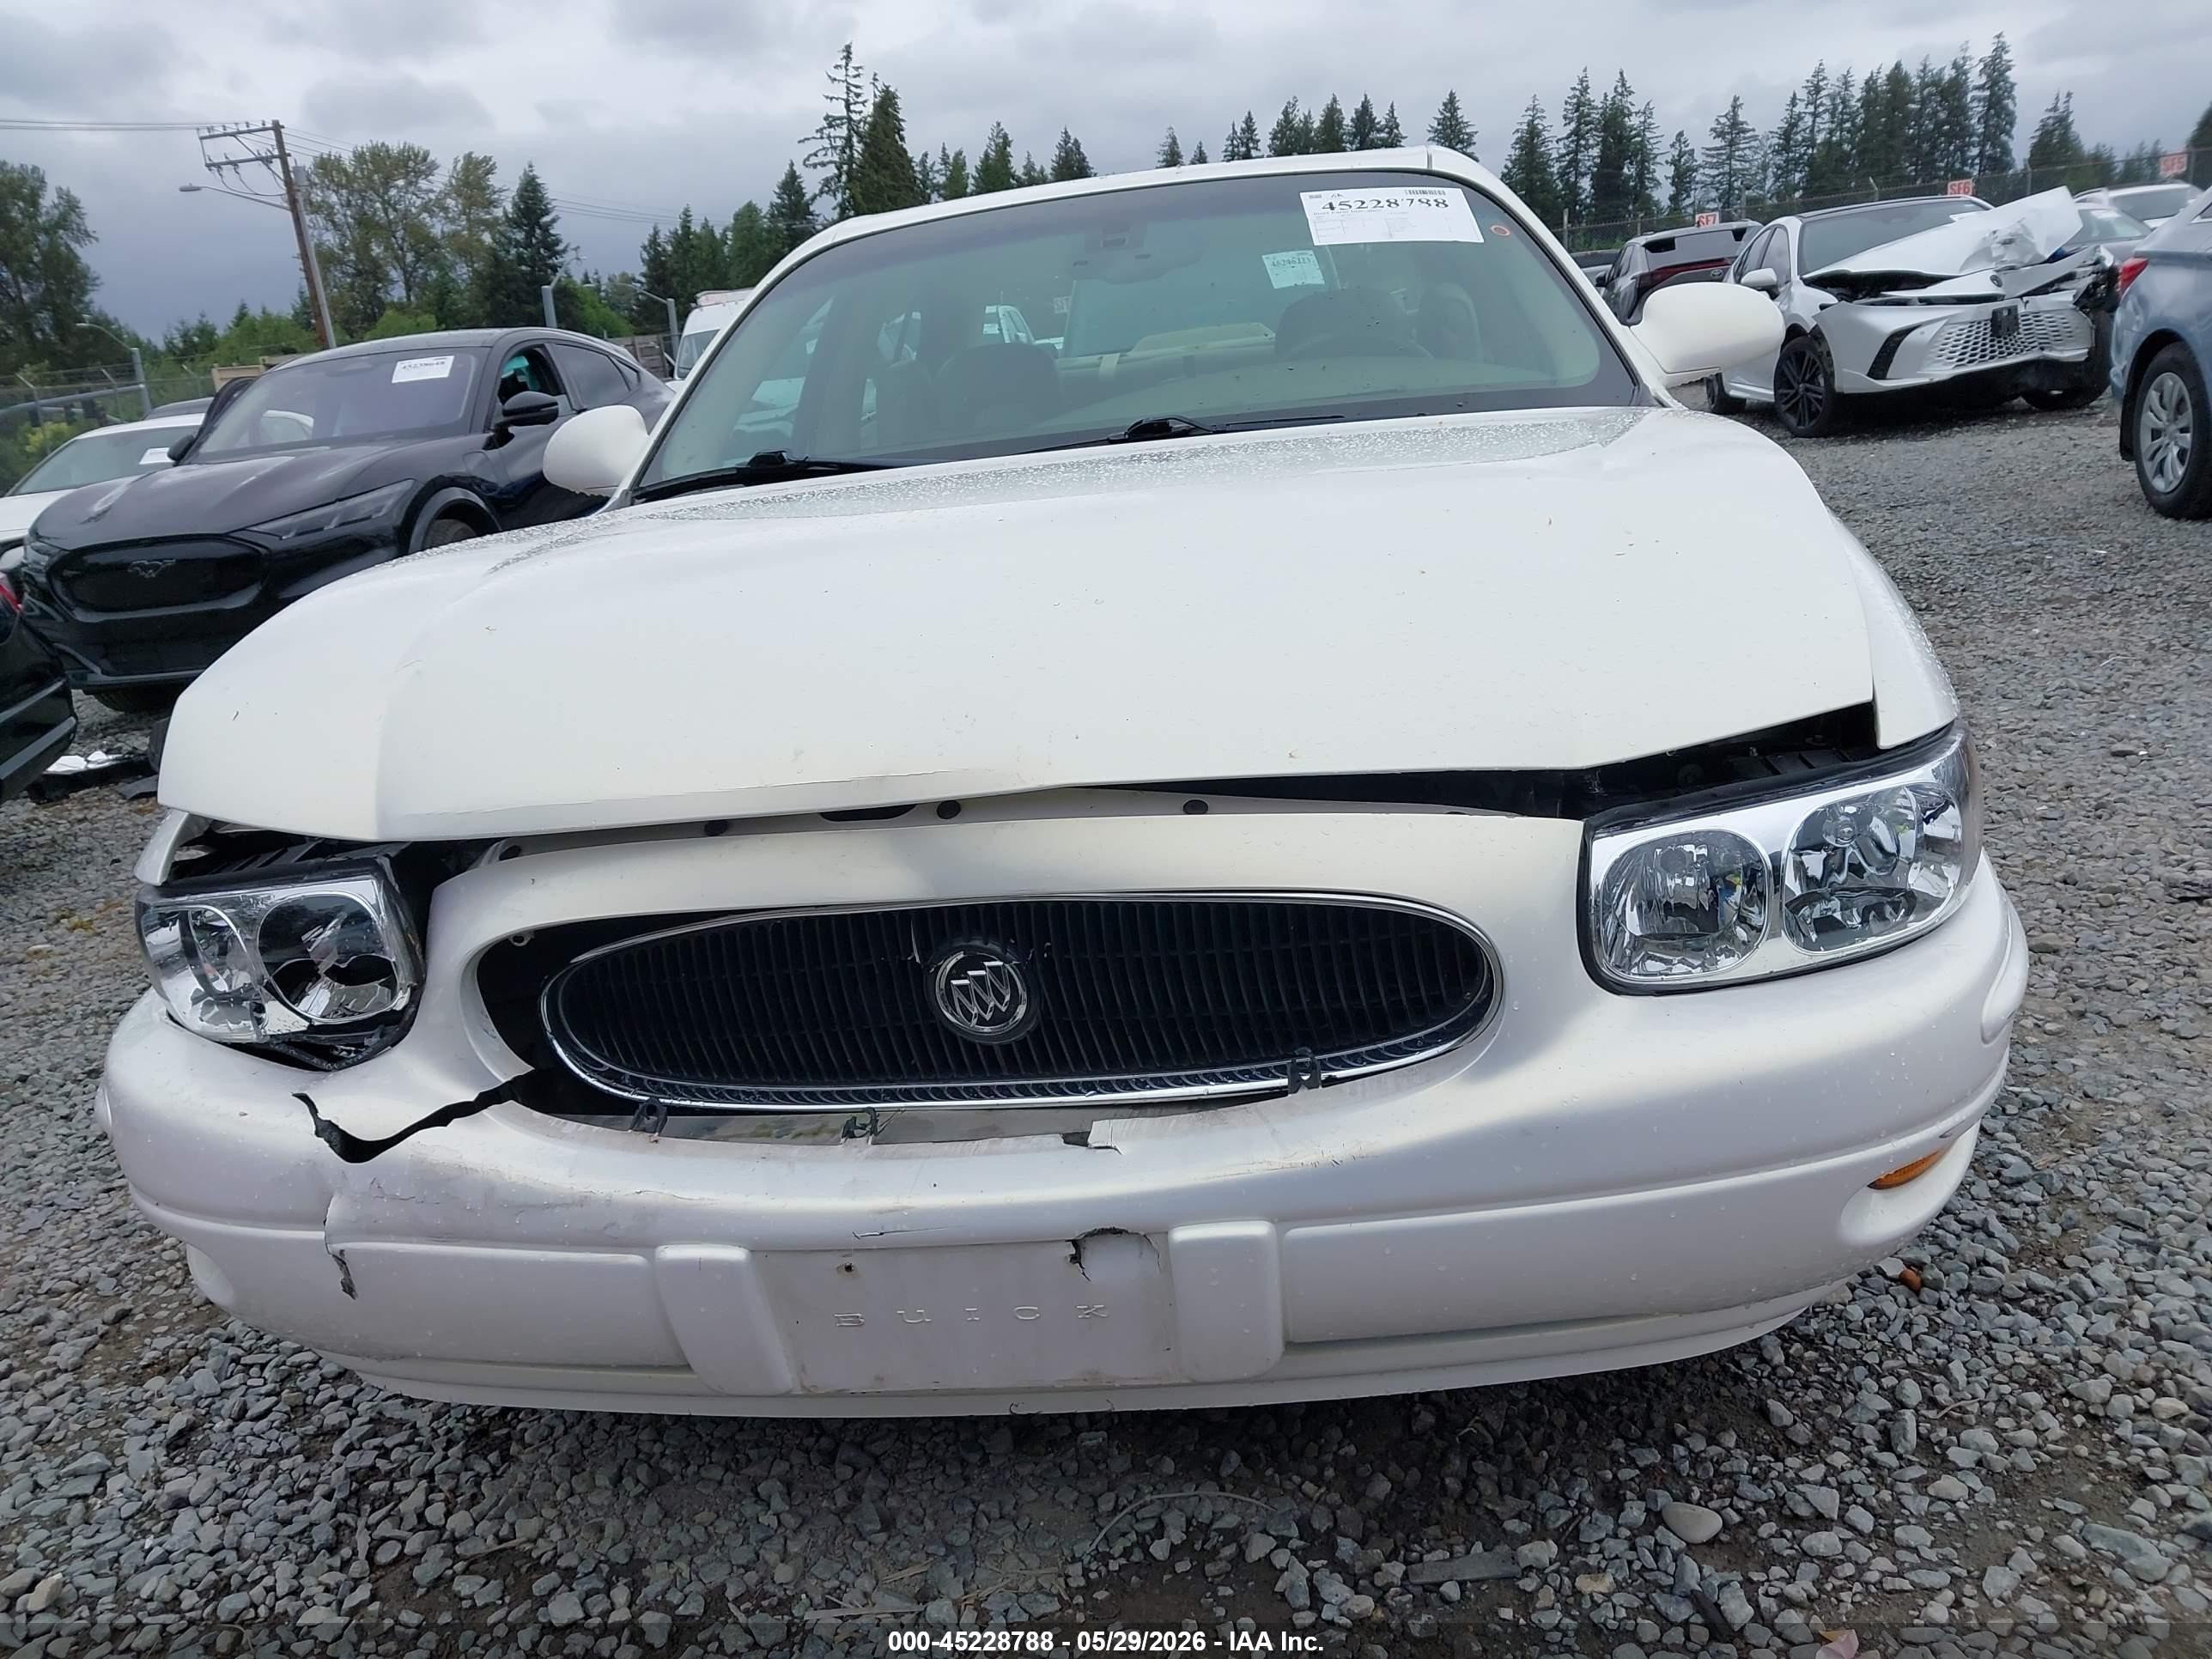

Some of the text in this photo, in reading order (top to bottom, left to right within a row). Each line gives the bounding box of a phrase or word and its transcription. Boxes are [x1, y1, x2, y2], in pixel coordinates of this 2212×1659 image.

[1950, 180, 1970, 194] SF6
[1322, 198, 1449, 210] 45228788
[1697, 213, 1717, 227] SF7
[834, 1304, 1108, 1327] BUICK
